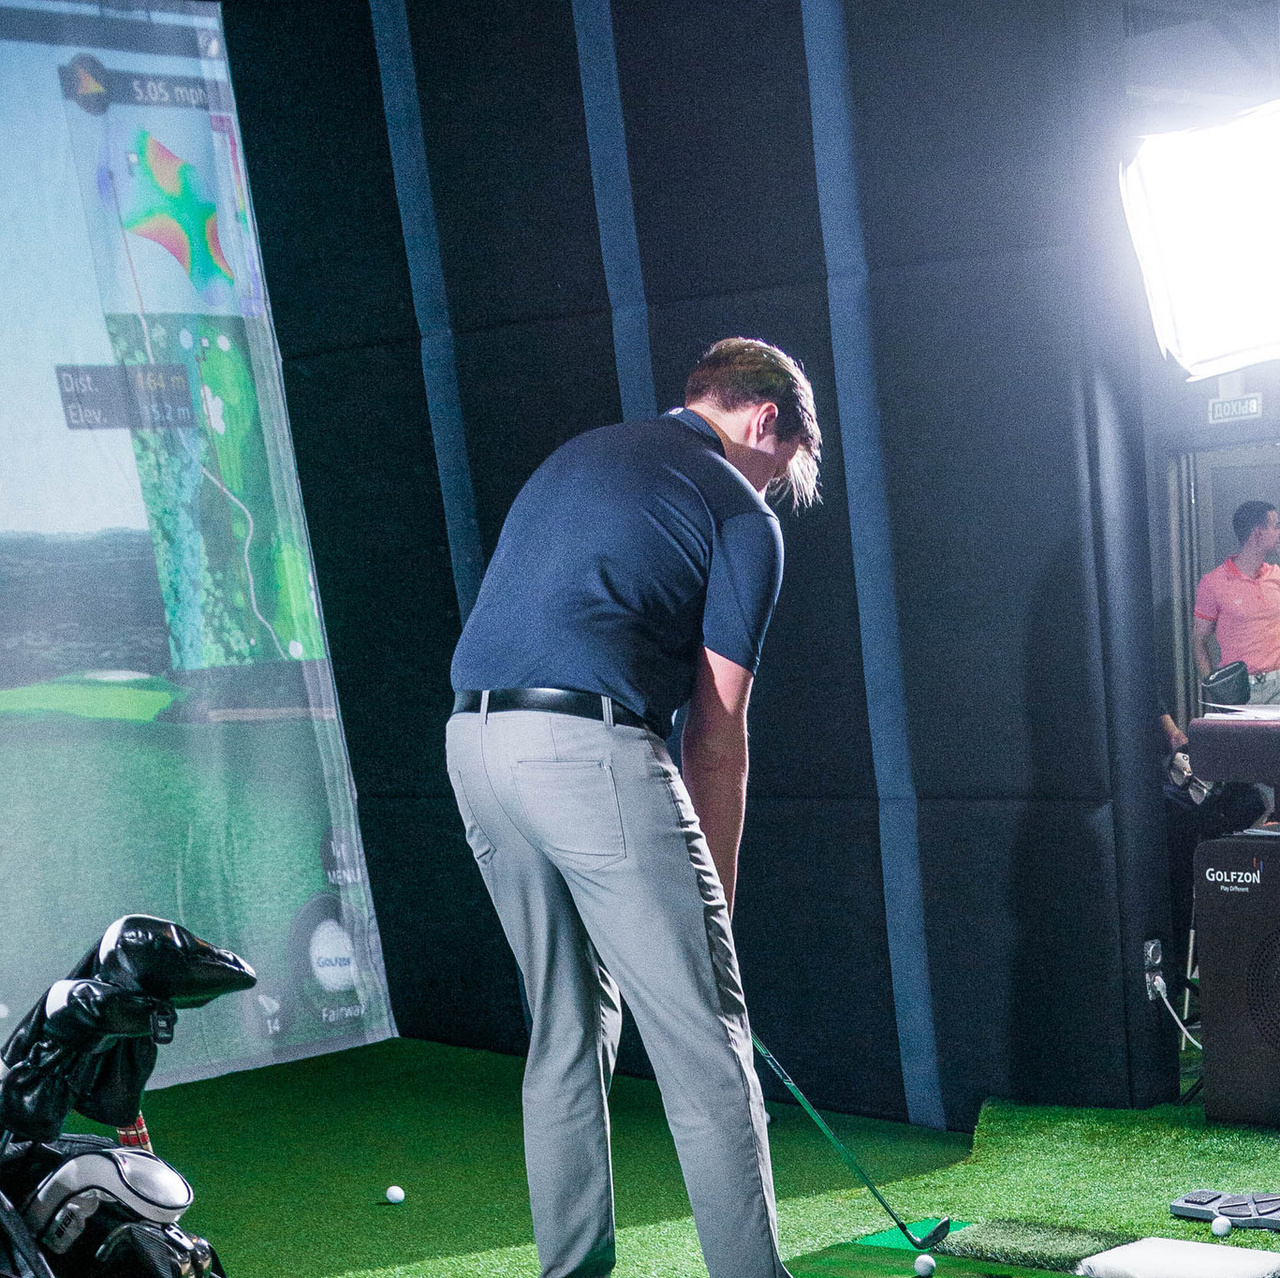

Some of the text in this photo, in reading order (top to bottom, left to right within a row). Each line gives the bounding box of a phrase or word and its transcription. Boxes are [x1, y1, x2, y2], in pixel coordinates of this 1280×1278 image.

[132, 79, 208, 105] 5.05 mph
[62, 372, 99, 393] Dist.
[67, 402, 108, 424] Elev.
[1205, 867, 1260, 884] GOLFZON
[266, 1018, 281, 1034] 14
